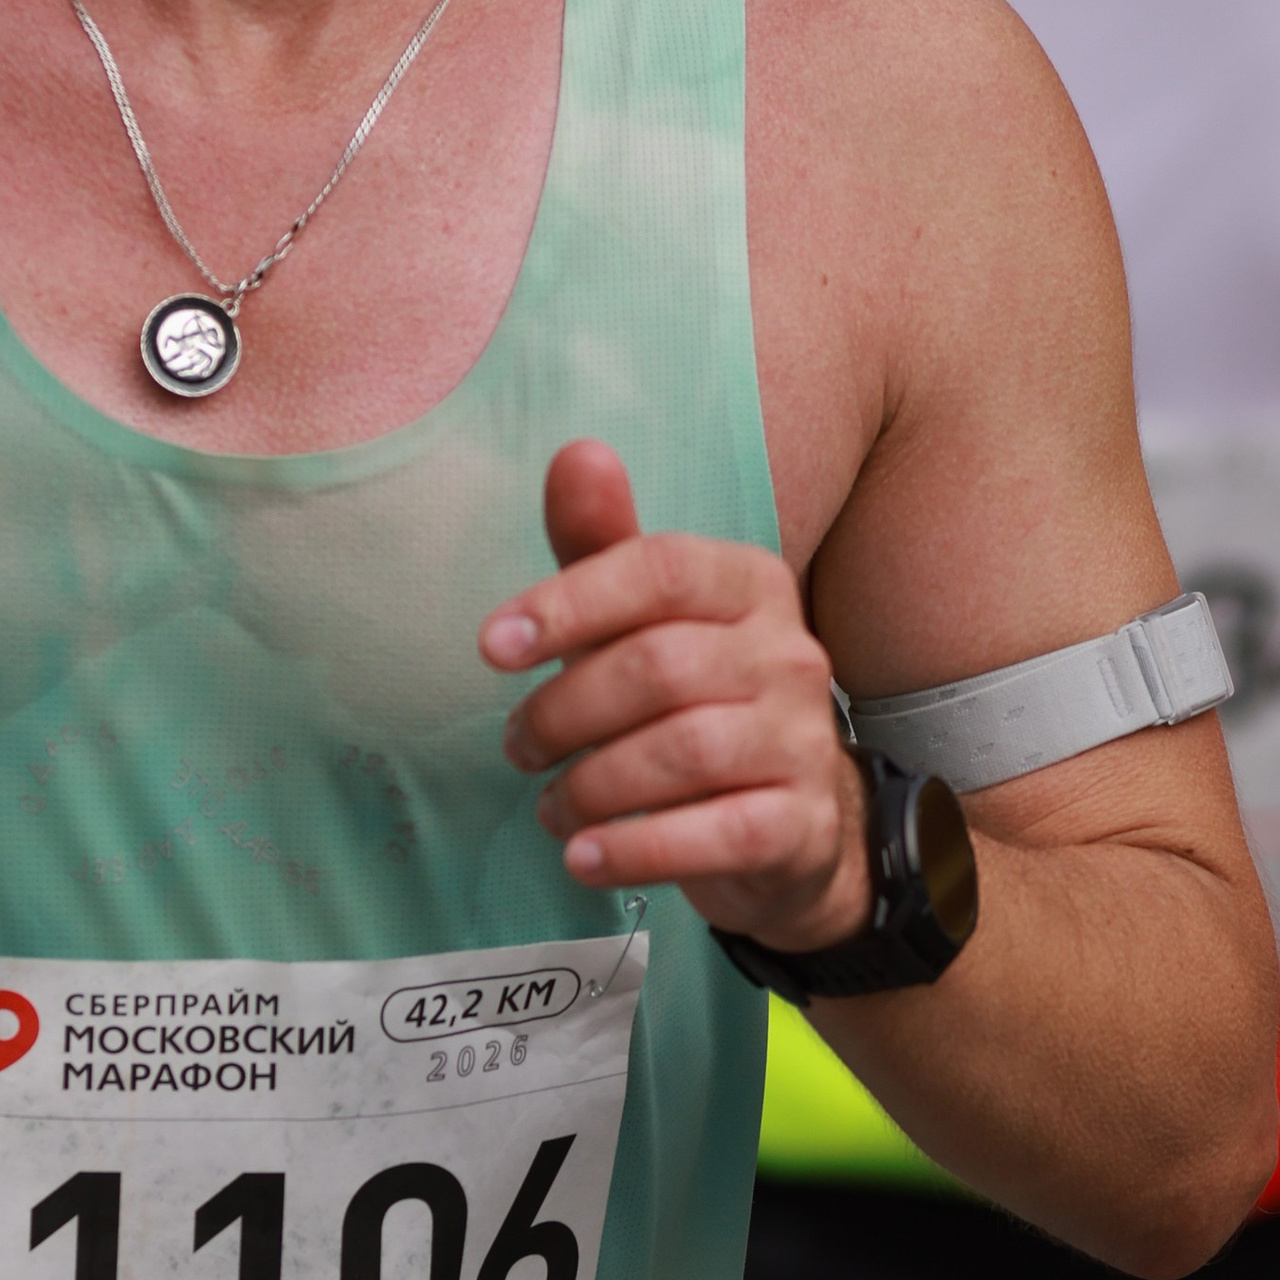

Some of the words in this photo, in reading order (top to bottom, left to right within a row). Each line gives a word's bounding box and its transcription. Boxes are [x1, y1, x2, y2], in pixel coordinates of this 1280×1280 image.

[65, 987, 279, 1016] СБЕРПРАЙМ
[404, 989, 483, 1028] 42,2
[63, 1019, 355, 1054] МОСКОВСКИЙ
[426, 1035, 529, 1082] 2026
[62, 1062, 277, 1091] МАРАФОН
